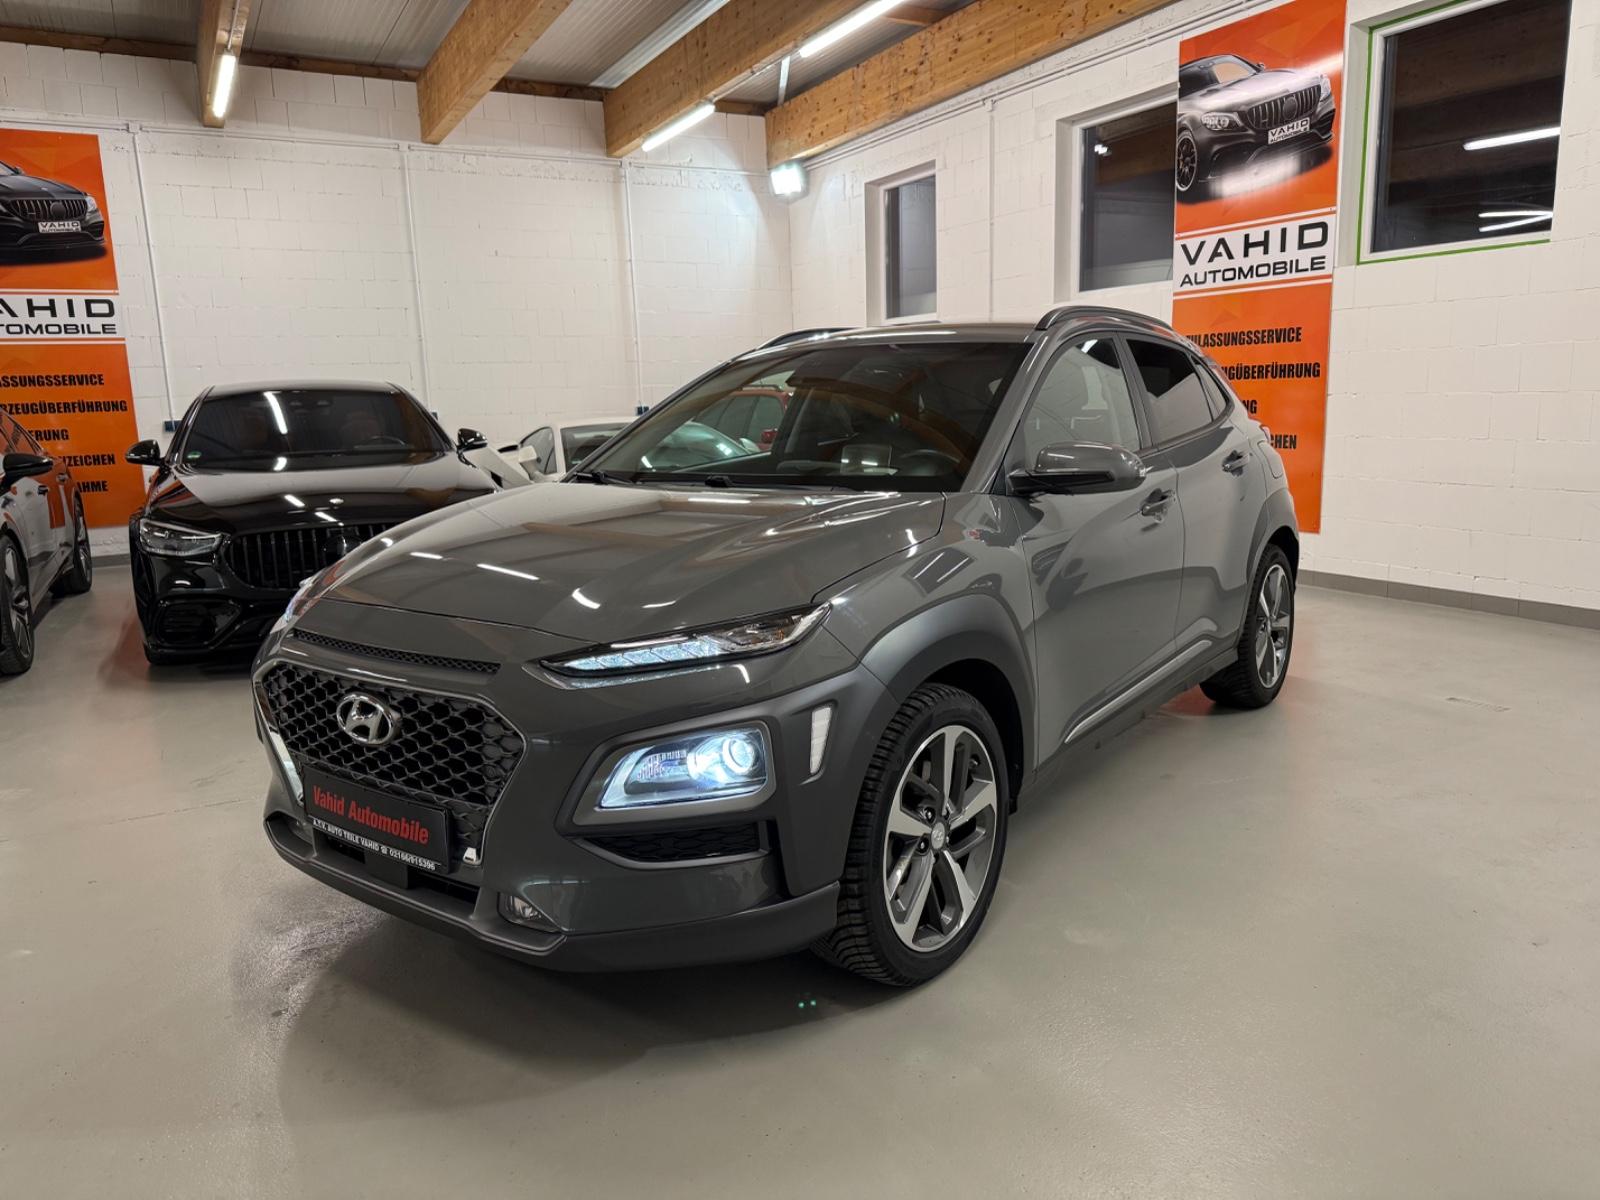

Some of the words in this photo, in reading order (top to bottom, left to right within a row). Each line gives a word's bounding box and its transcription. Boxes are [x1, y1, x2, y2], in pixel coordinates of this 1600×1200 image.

[1180, 221, 1329, 266] VAHID
[1180, 255, 1326, 288] AUTOMOBILE
[0, 298, 115, 318] AHID
[313, 785, 345, 816] Vahid
[348, 800, 430, 846] Automobile
[360, 836, 379, 852] VAHID
